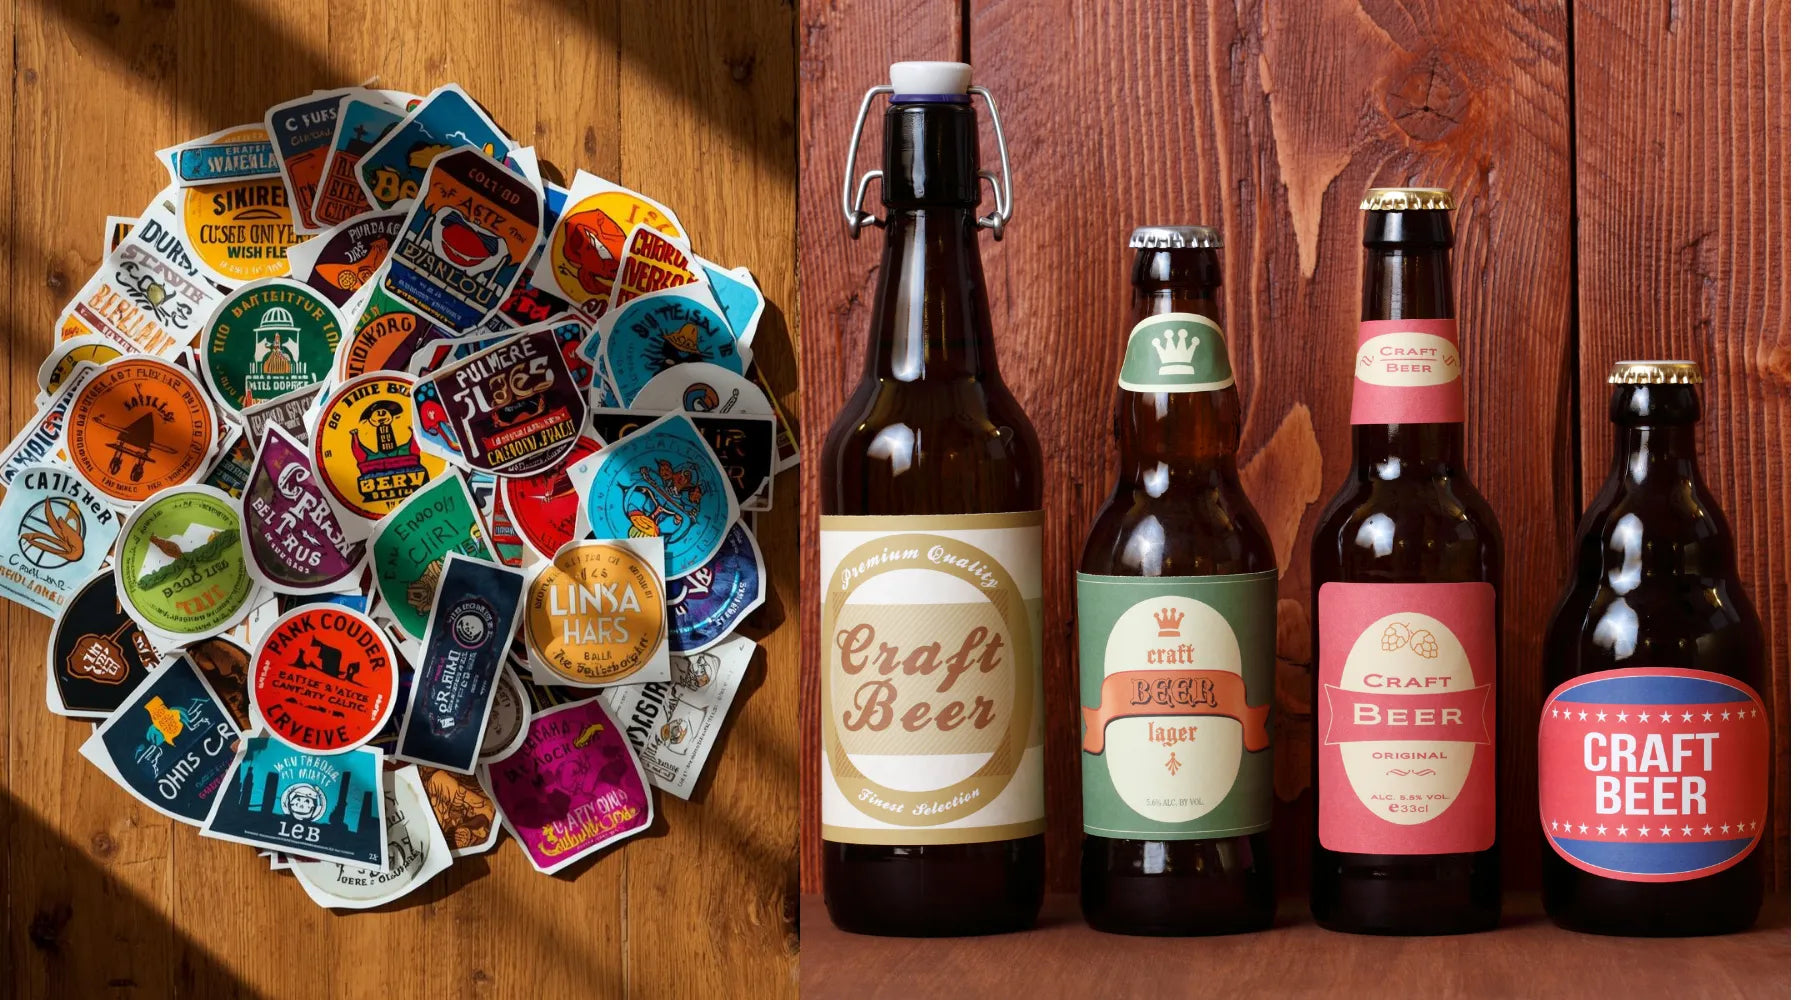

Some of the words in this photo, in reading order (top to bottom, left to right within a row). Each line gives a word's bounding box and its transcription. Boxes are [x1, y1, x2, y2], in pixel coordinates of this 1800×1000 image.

[228, 246, 262, 259] WISH
[840, 547, 920, 590] Premium
[926, 545, 1000, 589] Quality
[320, 613, 386, 673] COUDER
[836, 623, 1005, 693] Craft
[1146, 643, 1196, 665] craft
[842, 678, 997, 732] Beer
[1130, 678, 1218, 709] BEER
[1147, 721, 1198, 747] lager
[1371, 752, 1448, 760] ORIGINAL
[1583, 731, 1720, 773] CRAFT
[857, 787, 905, 814] Finest
[912, 787, 981, 816] Selection
[1179, 799, 1188, 807] BY
[1595, 775, 1707, 816] BEER
